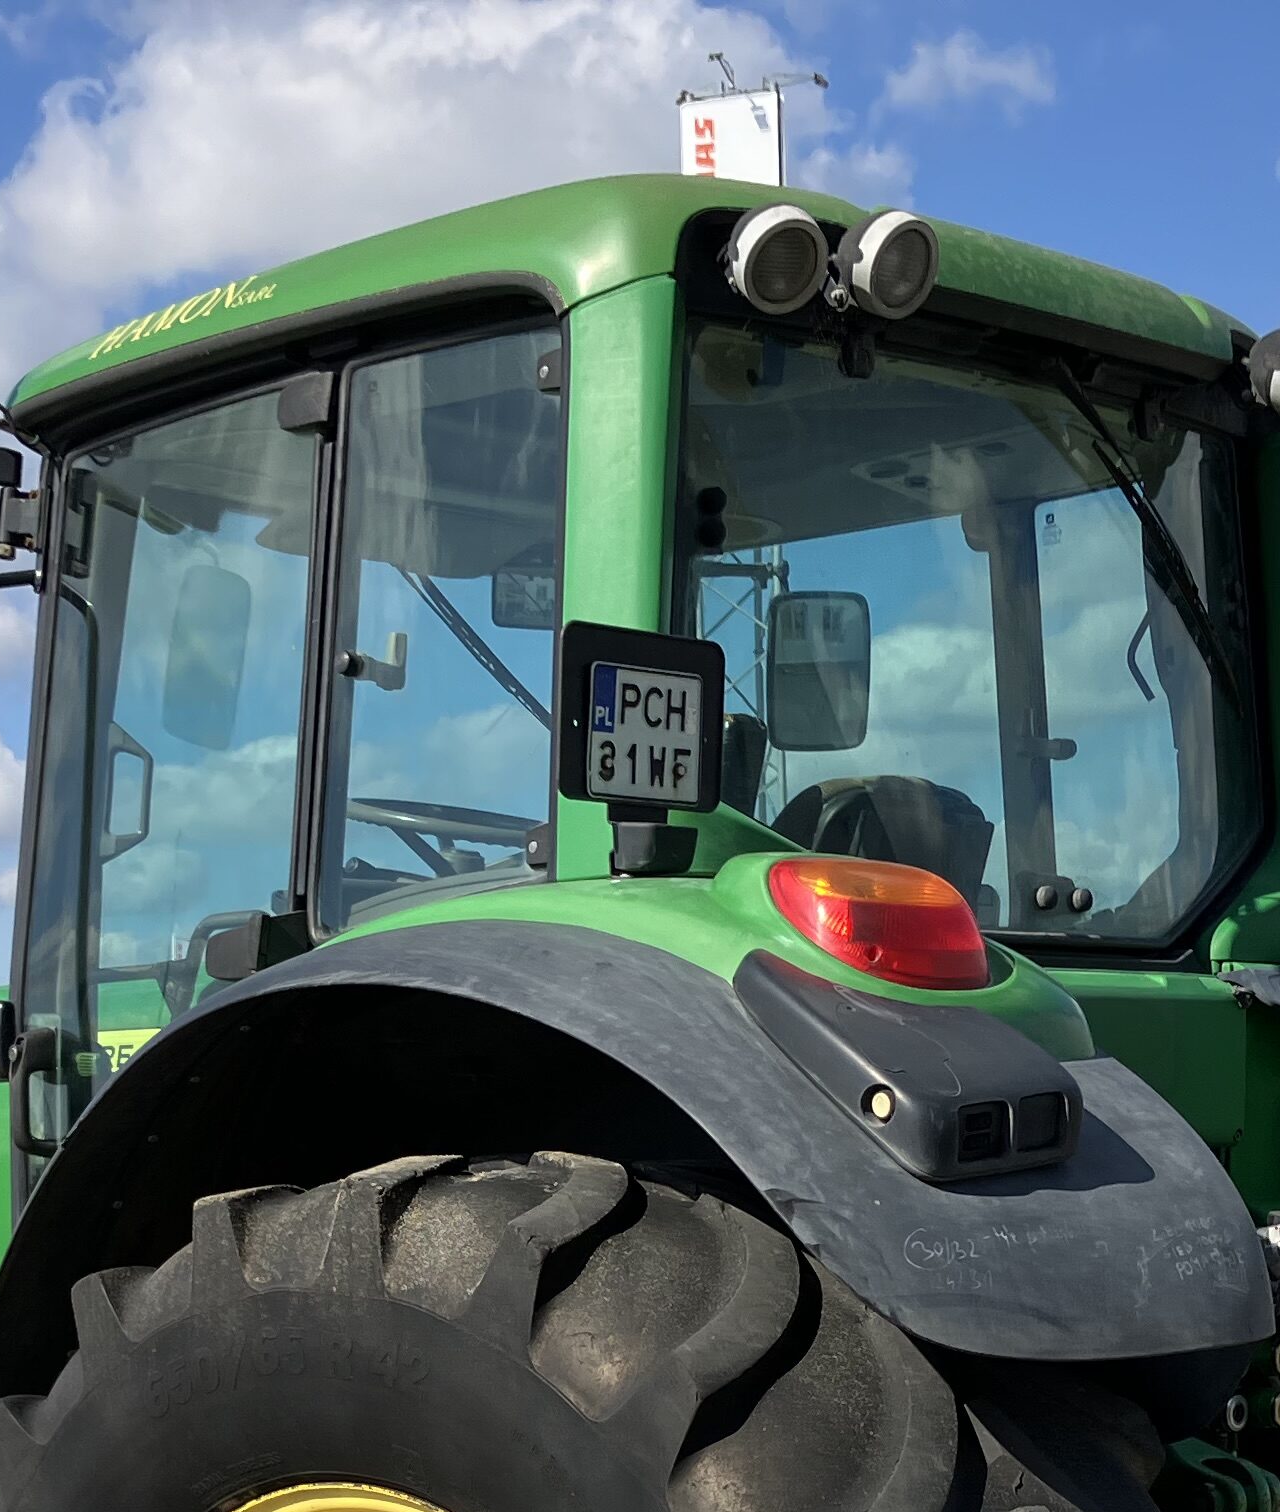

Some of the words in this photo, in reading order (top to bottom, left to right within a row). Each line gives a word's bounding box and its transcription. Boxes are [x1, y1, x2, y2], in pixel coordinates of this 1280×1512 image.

[595, 705, 613, 728] PL
[620, 683, 687, 732] PCH
[148, 1325, 306, 1418] 650/65
